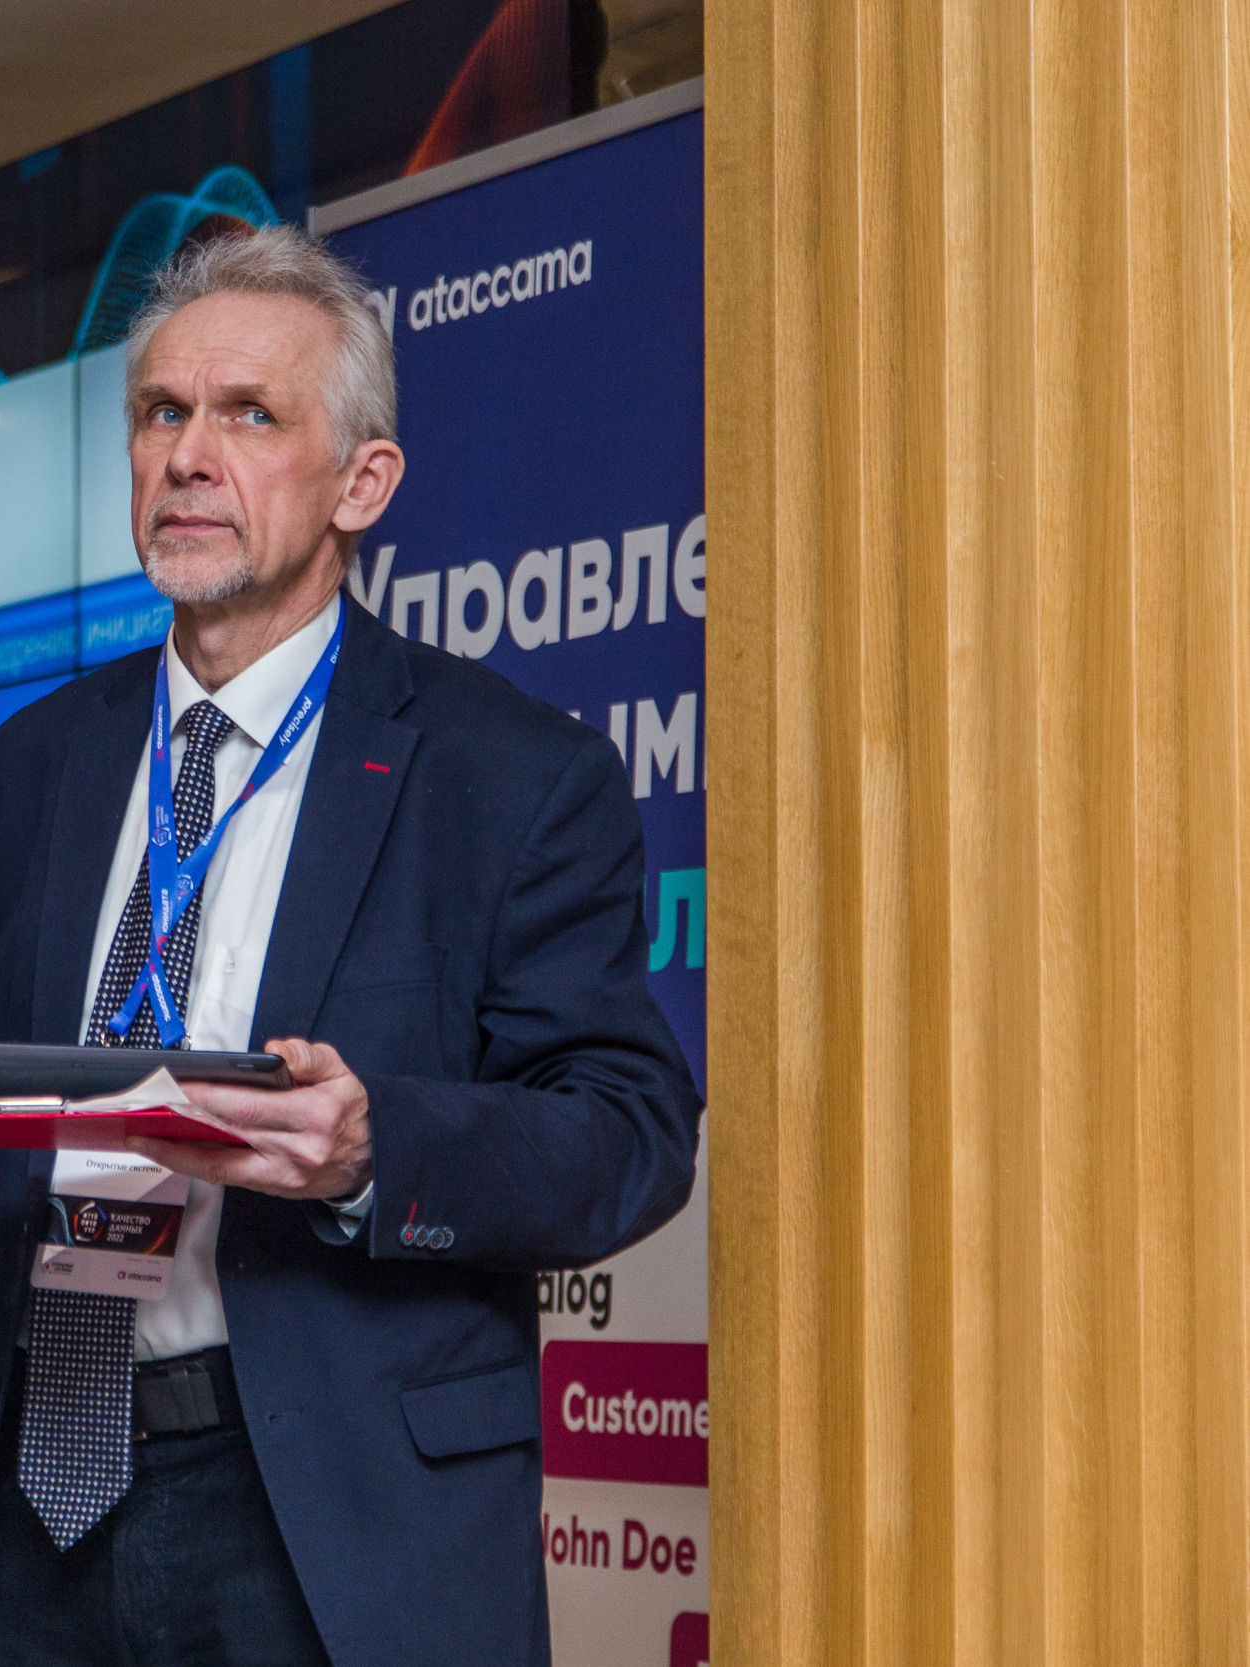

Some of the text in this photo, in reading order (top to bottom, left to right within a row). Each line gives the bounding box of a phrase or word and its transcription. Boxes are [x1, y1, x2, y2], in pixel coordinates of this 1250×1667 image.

[408, 239, 593, 332] ataccama
[278, 695, 313, 747] precisely
[86, 1160, 128, 1173] Открытые
[111, 1213, 151, 1226] КАЧЕСТВО
[109, 1224, 143, 1235] ДАННЫХ
[107, 1233, 125, 1243] 2022
[622, 1518, 697, 1576] Doe
